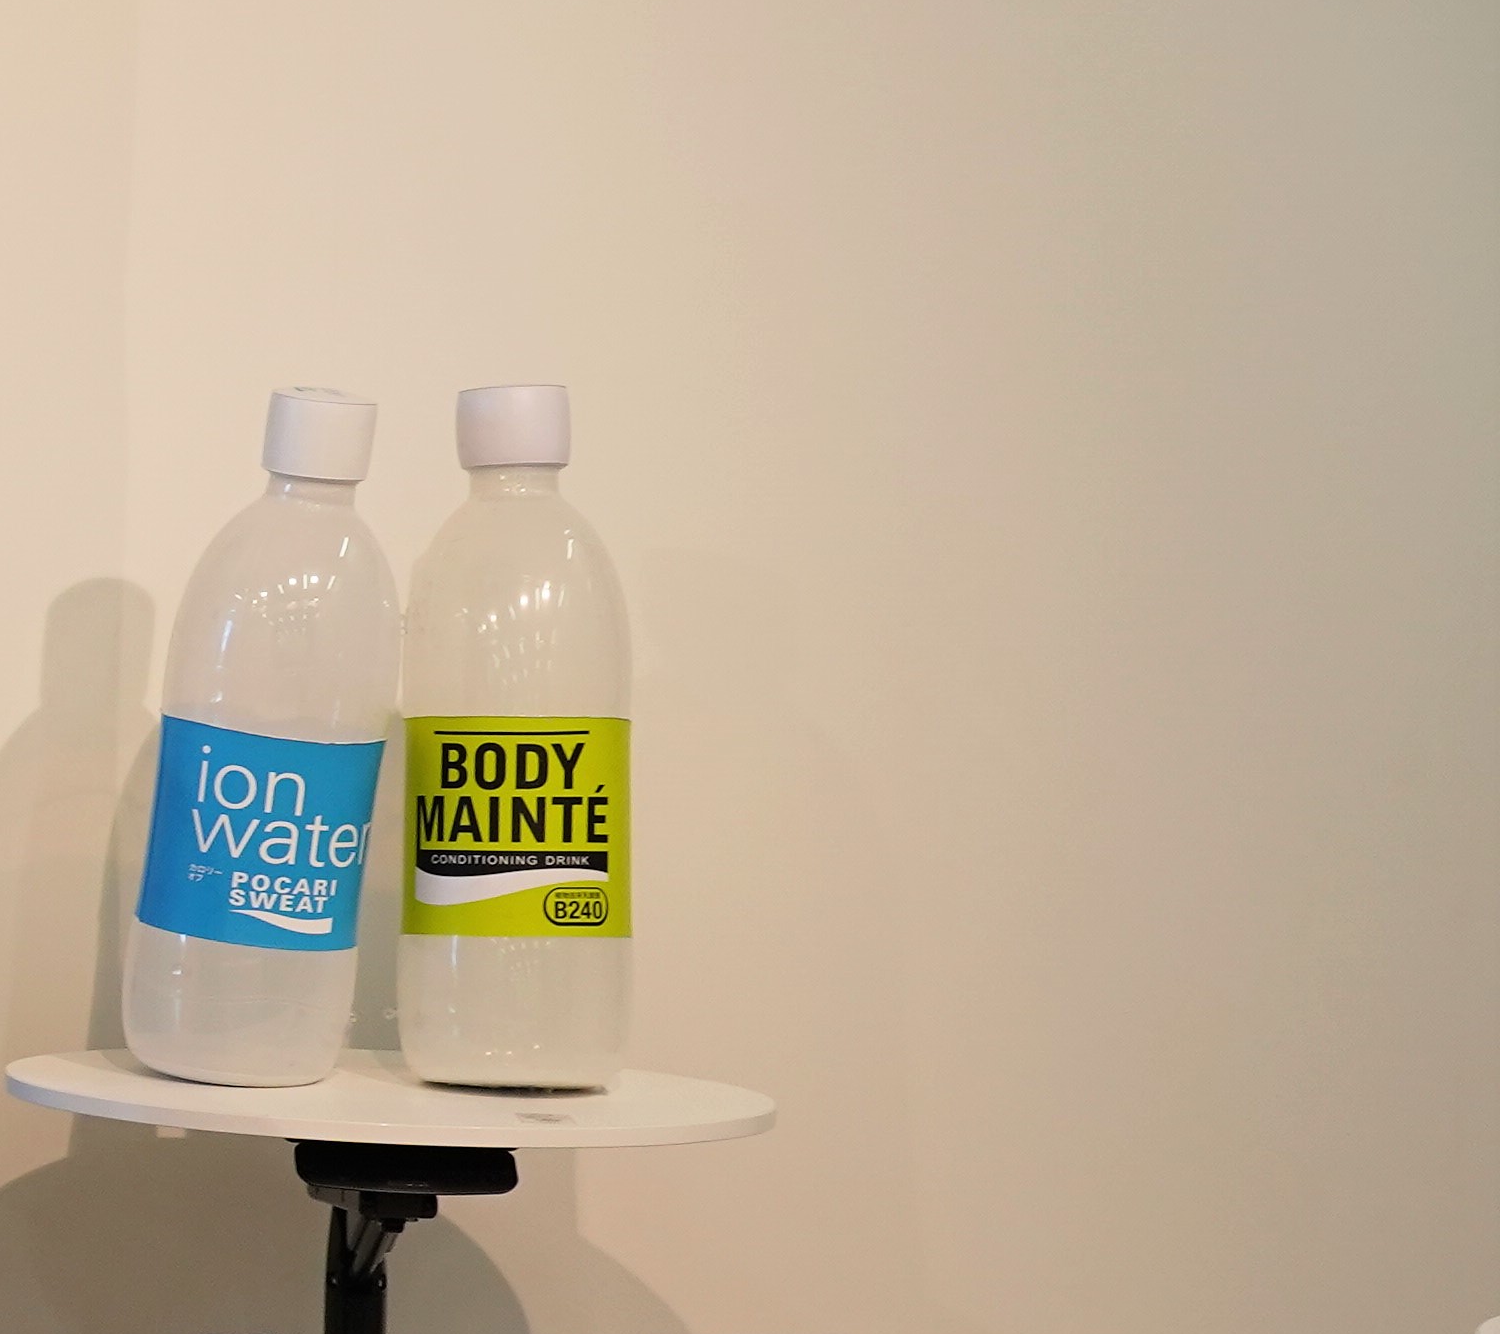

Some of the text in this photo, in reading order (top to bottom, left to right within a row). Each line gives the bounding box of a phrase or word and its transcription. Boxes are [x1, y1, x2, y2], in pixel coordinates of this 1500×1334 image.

[197, 745, 306, 816] ion
[441, 742, 586, 791] BODY
[416, 784, 609, 843] MAINTÉ
[192, 808, 371, 868] water
[430, 854, 590, 866] CONDITIONING DRINK
[229, 889, 327, 913] SWEAT
[231, 872, 337, 896] POCARI
[555, 901, 602, 919] B240
